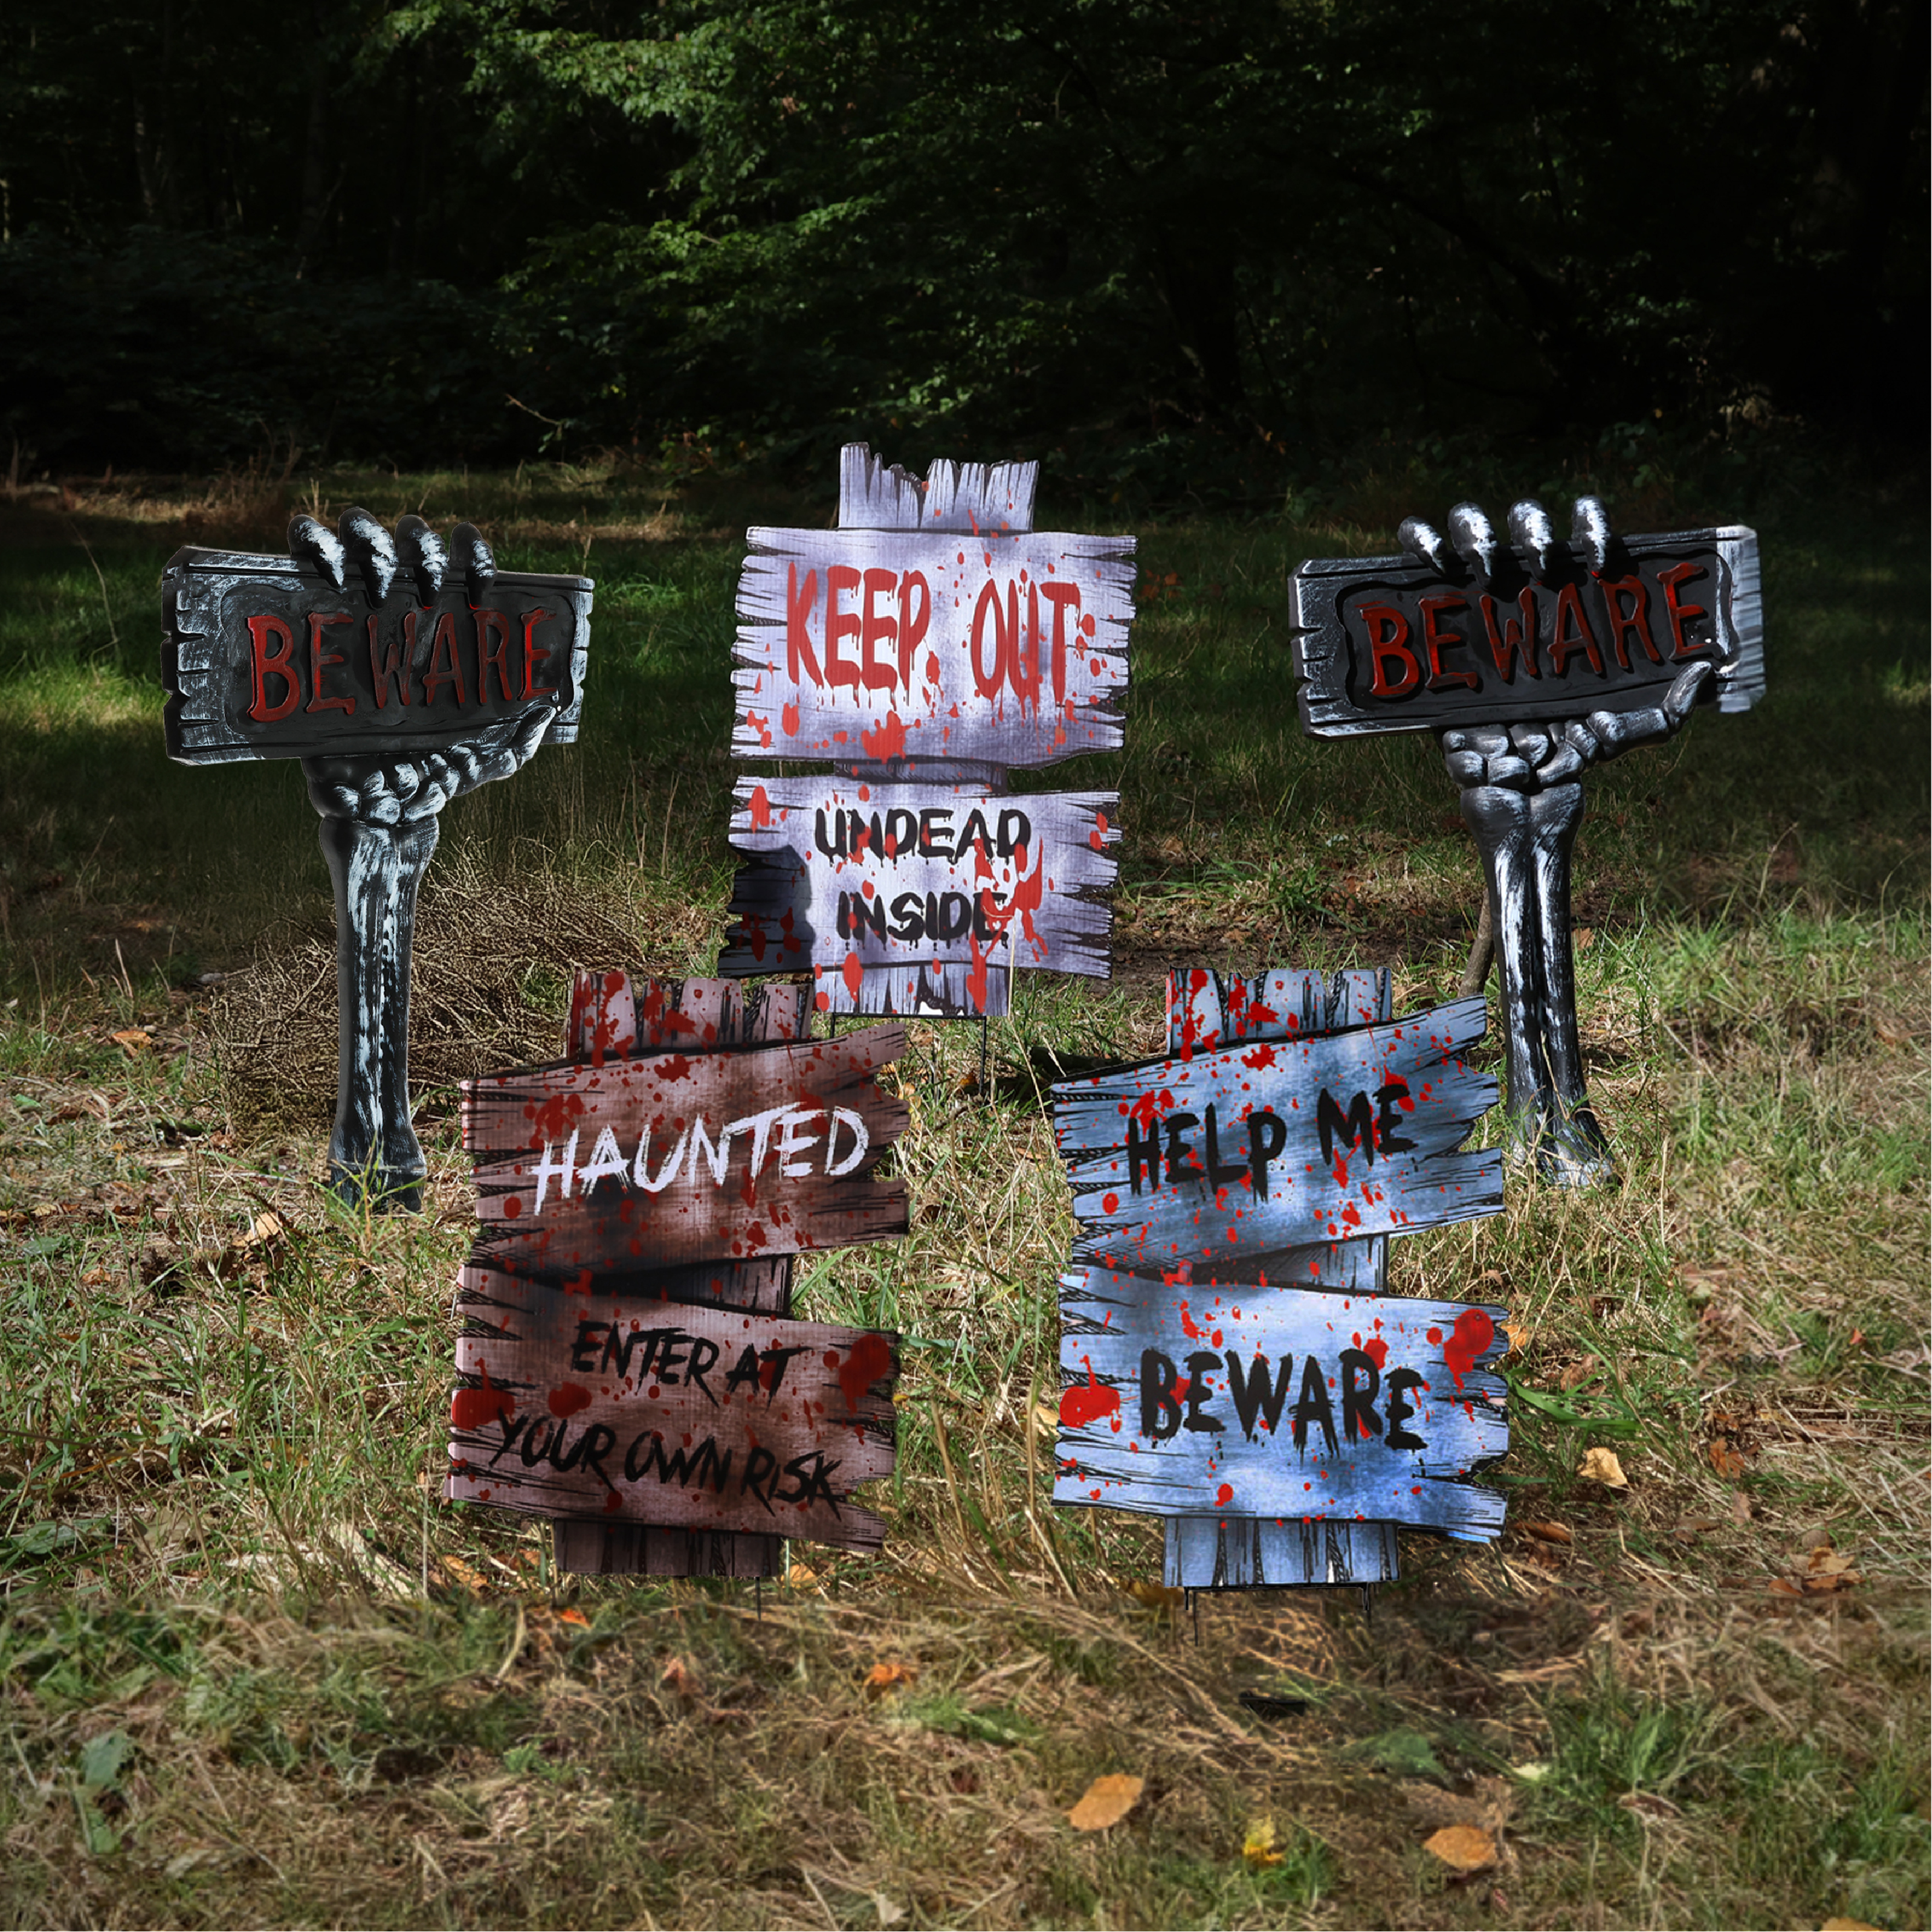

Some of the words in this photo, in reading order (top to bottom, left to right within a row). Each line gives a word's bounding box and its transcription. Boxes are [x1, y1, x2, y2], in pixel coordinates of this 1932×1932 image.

[247, 609, 556, 722] BEWARE
[787, 562, 931, 710] KEEP
[971, 578, 1081, 719] OUT
[1355, 562, 1720, 696] BEWARE
[815, 808, 1031, 867] UNDEAD
[837, 891, 1008, 950] INSIDE
[530, 1101, 869, 1216] HAUNTED
[1128, 1102, 1287, 1204] HELP
[1318, 1084, 1419, 1167] ME
[570, 1321, 720, 1408] ENTER
[726, 1343, 815, 1411] AT
[1140, 1347, 1428, 1464] BEWARE
[489, 1405, 617, 1493] YOUR
[624, 1430, 732, 1494] OWN
[740, 1446, 843, 1521] RISK
